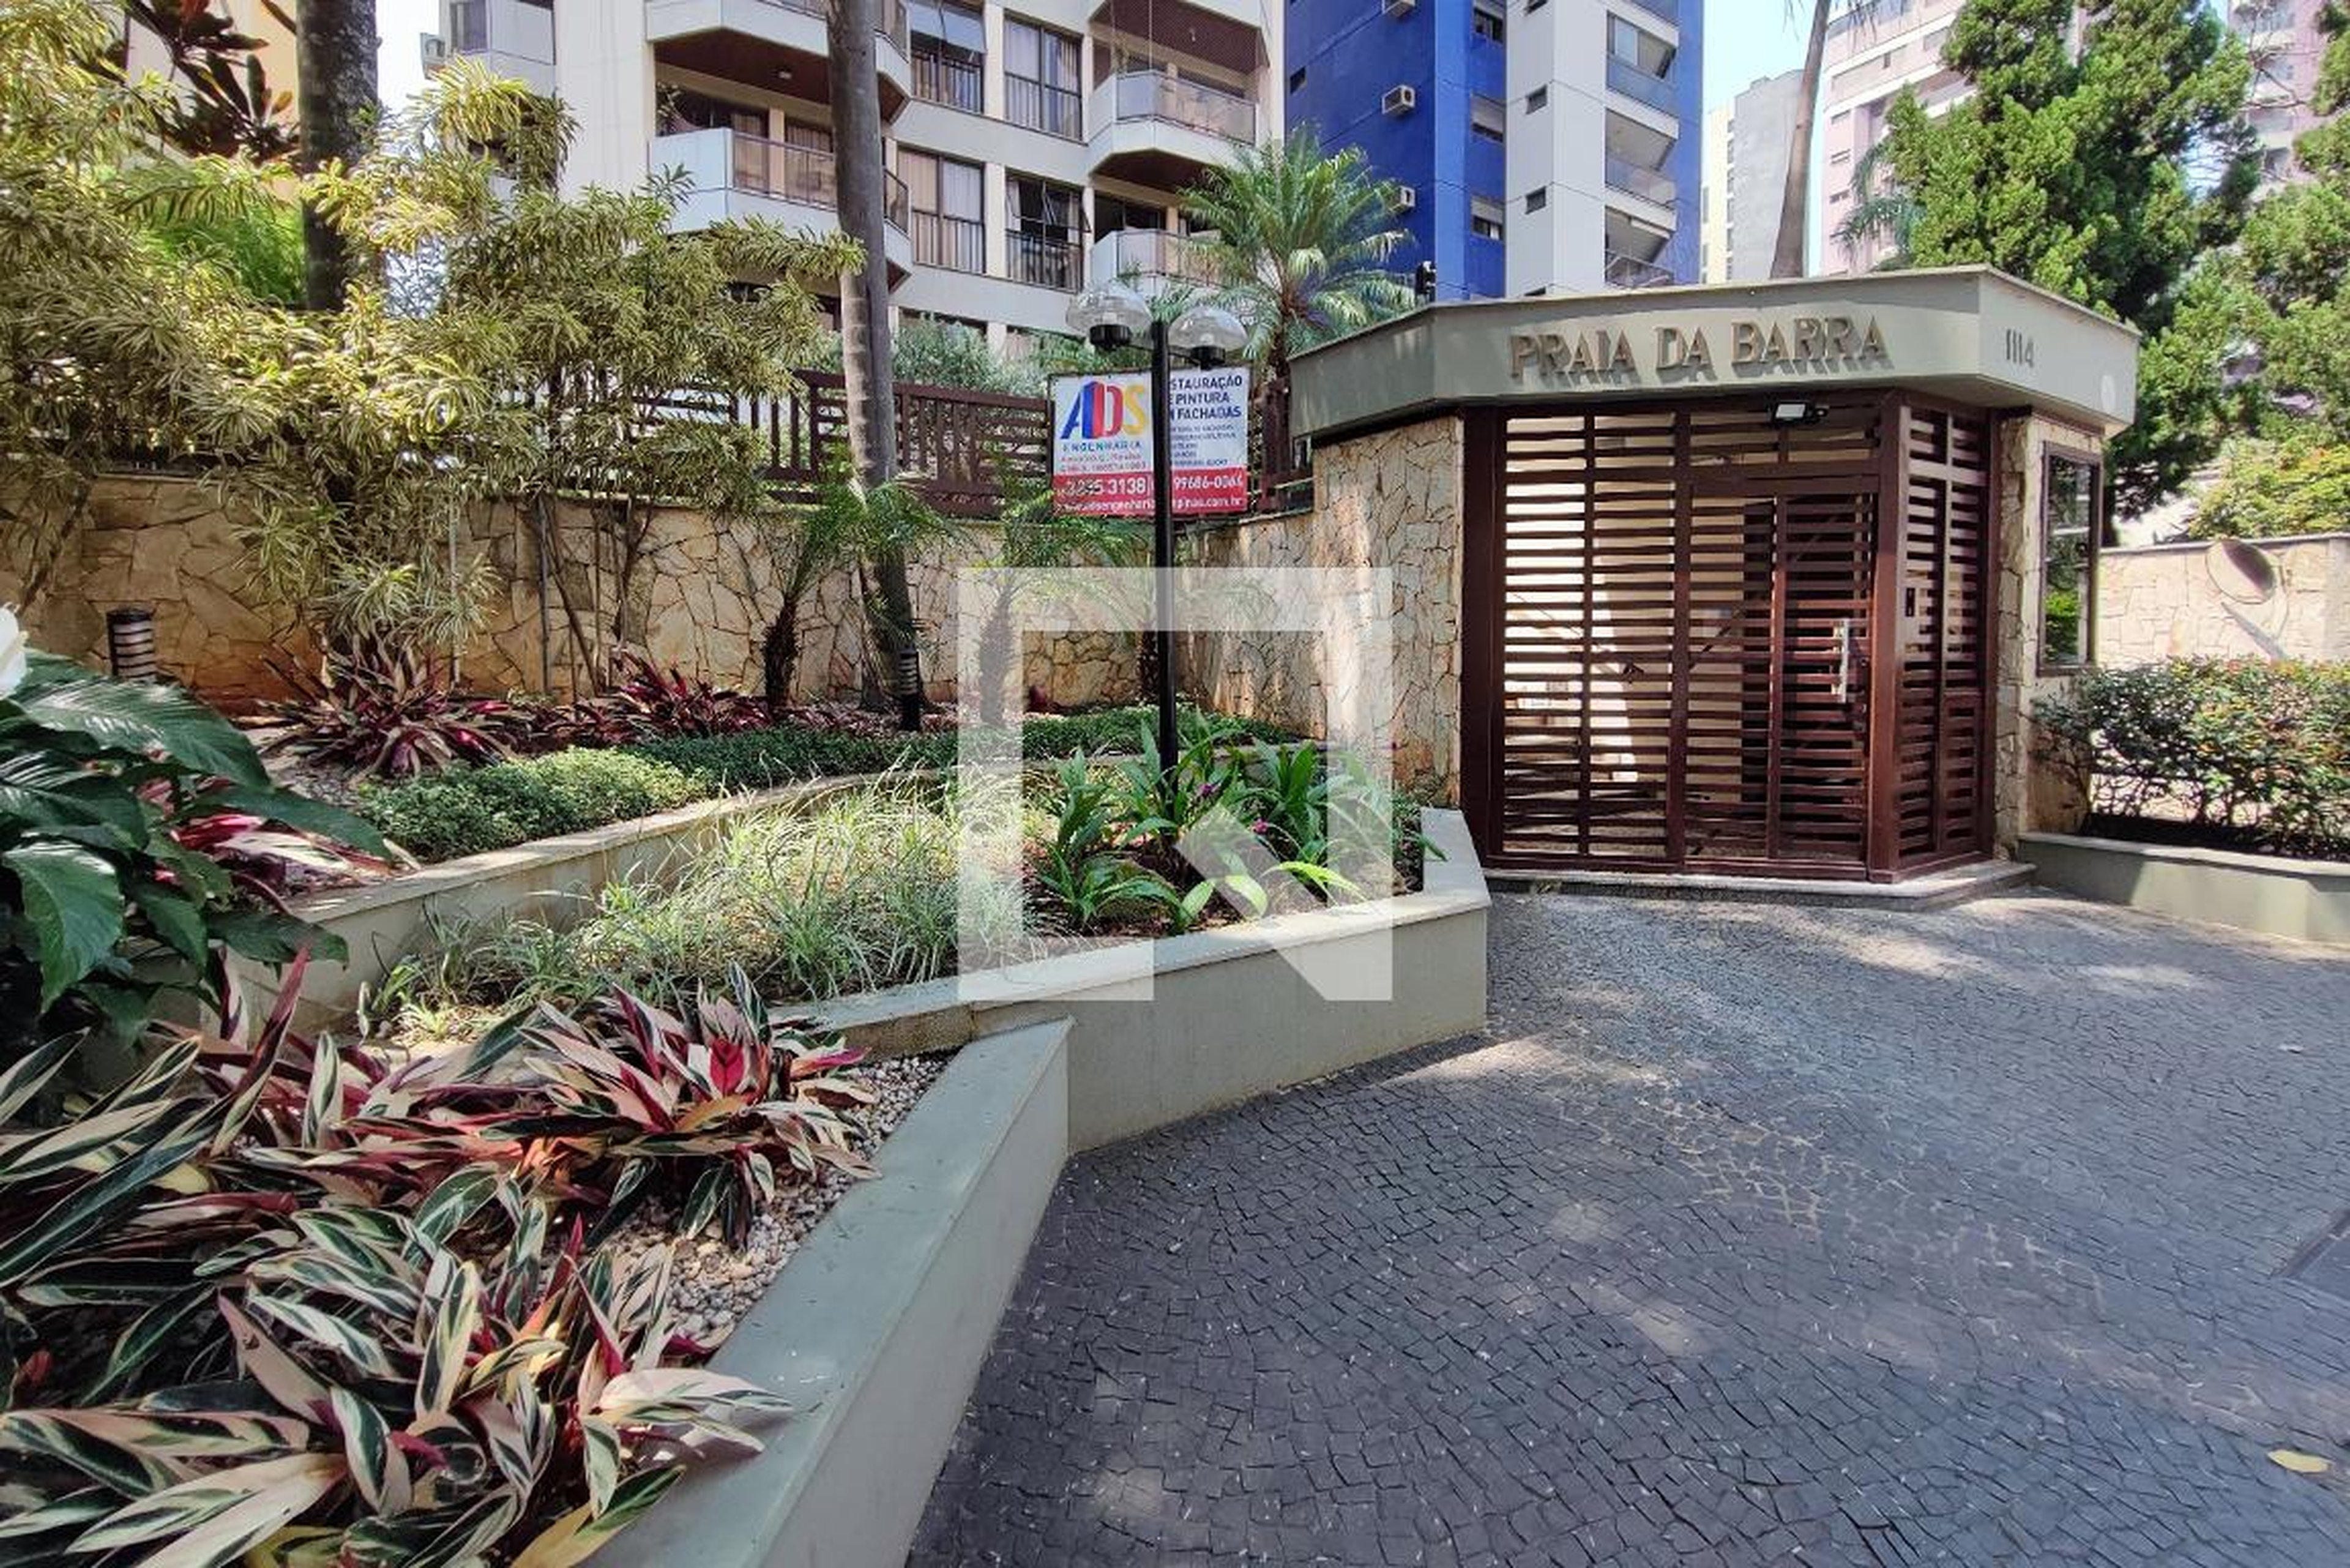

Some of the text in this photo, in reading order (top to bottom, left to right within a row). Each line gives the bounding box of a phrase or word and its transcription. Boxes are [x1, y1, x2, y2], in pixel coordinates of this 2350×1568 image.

[1510, 316, 1887, 376] PRAIA DA BARRA
[2006, 325, 2034, 368] 1114
[1171, 374, 1242, 390] STAURAÇÃO
[1176, 391, 1230, 405] PINTURA
[1060, 382, 1146, 439] ADS
[1177, 405, 1242, 419] FACHADAS
[1063, 441, 1141, 452] ENGENHARIA
[1108, 477, 1146, 494] 3138
